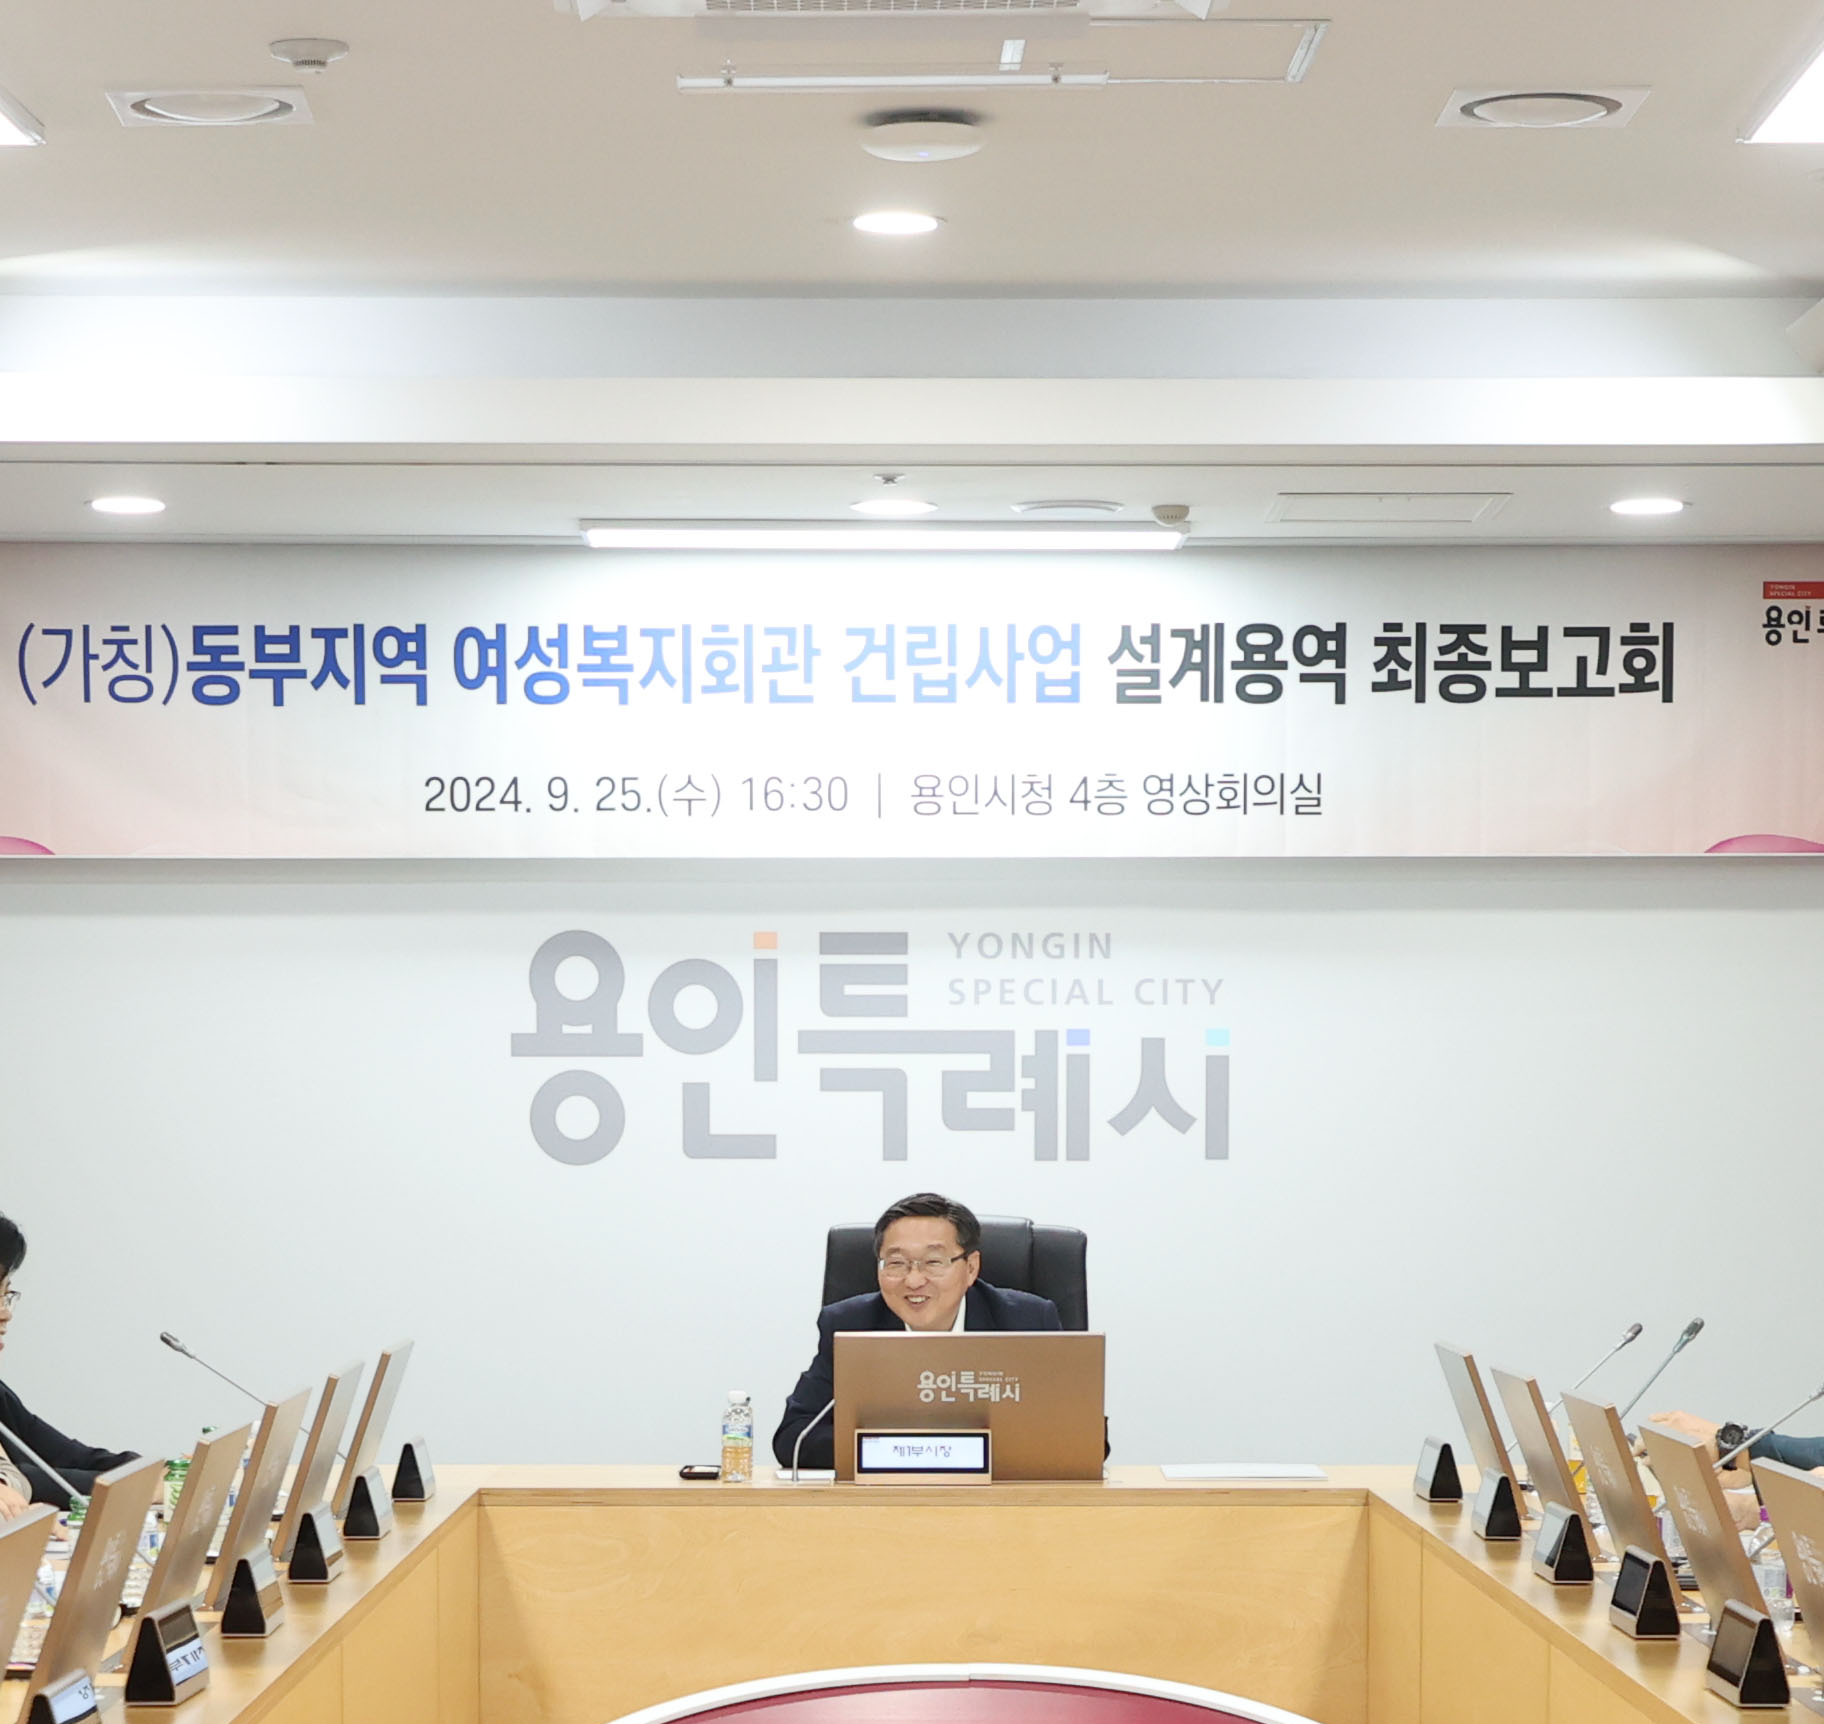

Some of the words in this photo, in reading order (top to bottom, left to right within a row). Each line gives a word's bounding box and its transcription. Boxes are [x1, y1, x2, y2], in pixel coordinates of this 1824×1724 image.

[1762, 605, 1811, 646] 용인
[19, 624, 429, 708] (가칭)동부지역
[454, 624, 822, 706] 여성복지회관
[845, 625, 1081, 704] 건립사업
[1109, 623, 1348, 706] 설계용역
[1372, 623, 1675, 705] 최종보고회
[425, 776, 533, 815] 2024.
[548, 776, 581, 815] 9.
[596, 775, 722, 819] 25.(수)
[742, 777, 850, 813] 16:30
[911, 774, 1054, 818] 용인시청
[1069, 774, 1130, 818] 4층
[1143, 772, 1324, 818] 영상회의실
[947, 932, 1112, 960] YONGIN
[947, 978, 1113, 1006] SPECIAL
[1133, 978, 1225, 1006] CITY
[511, 929, 1230, 1166] 용인특례시
[917, 1370, 1020, 1402] 용인특례시
